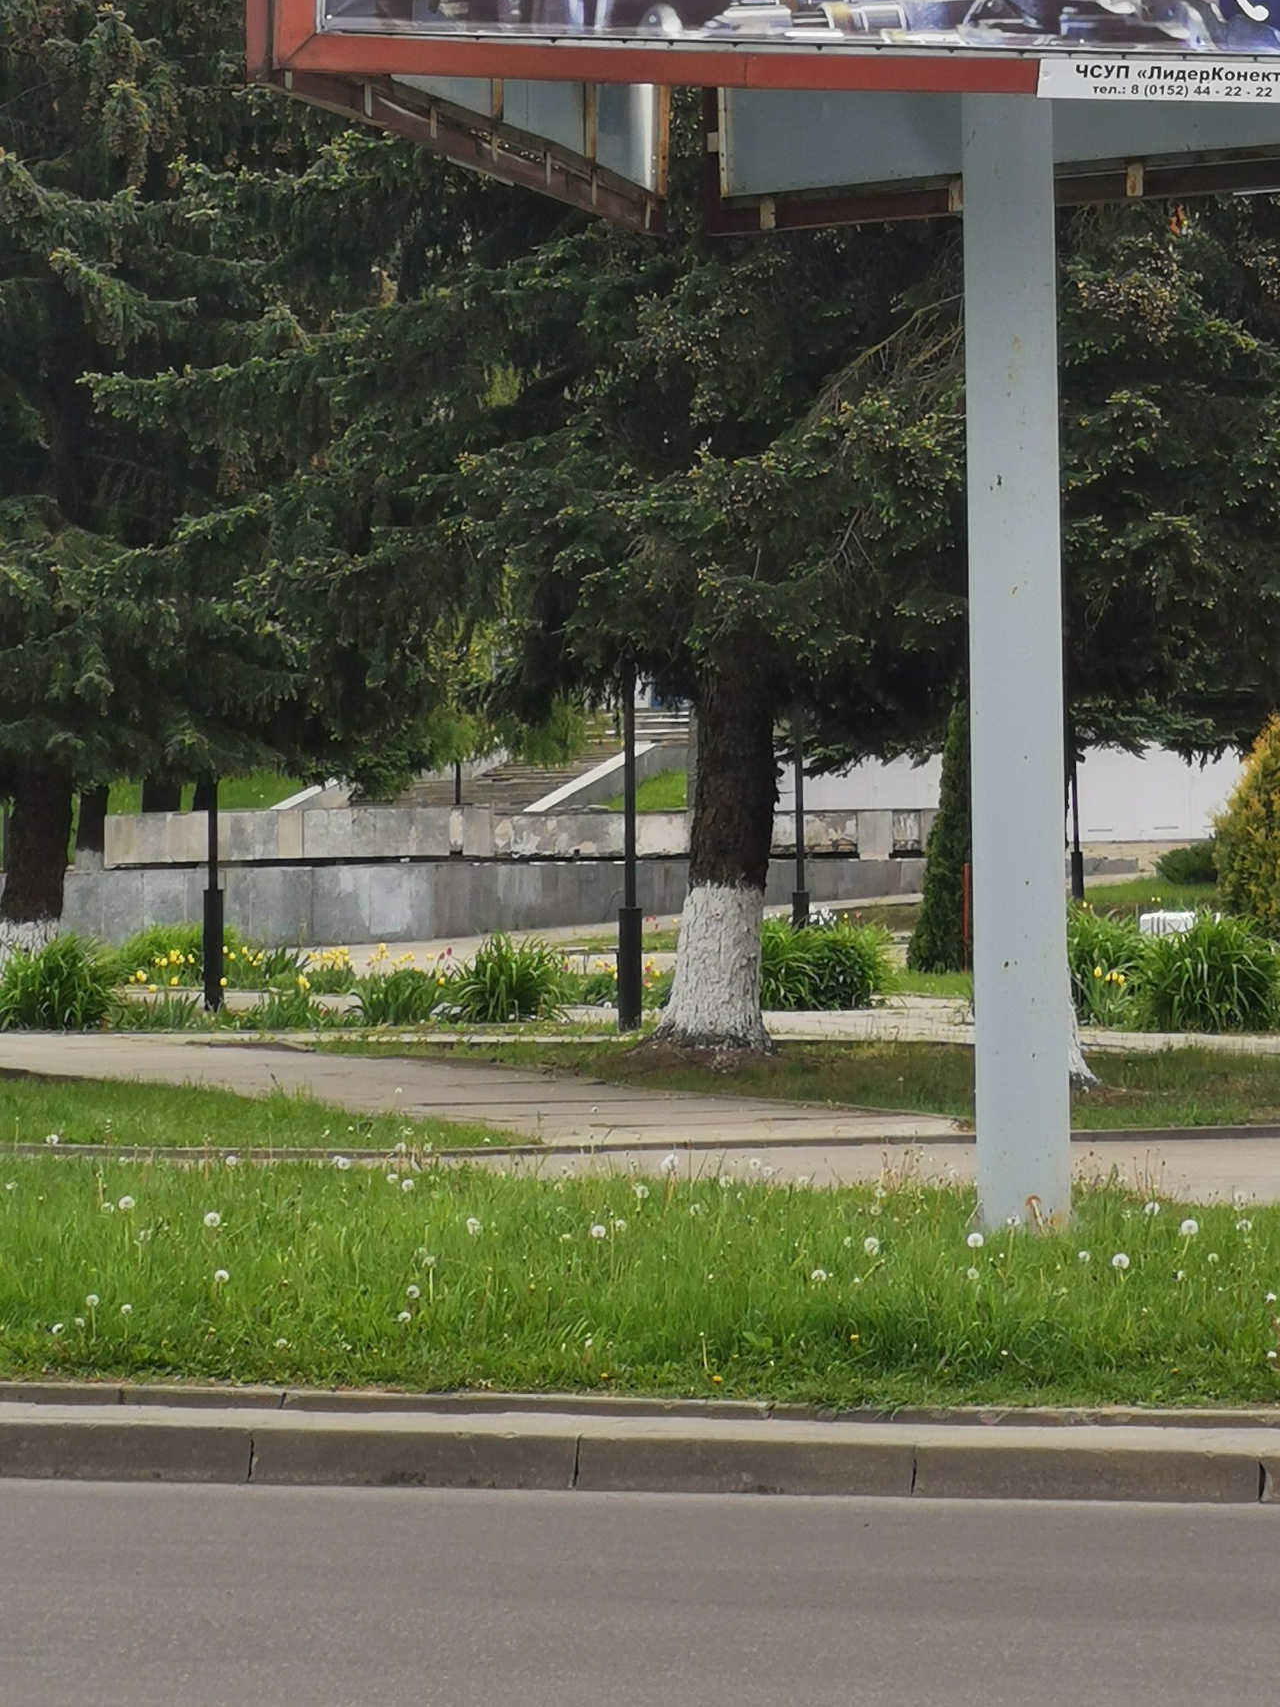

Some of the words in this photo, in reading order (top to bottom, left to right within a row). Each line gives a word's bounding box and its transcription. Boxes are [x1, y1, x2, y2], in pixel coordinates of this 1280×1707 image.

[1075, 64, 1130, 80] ЧСУП
[1092, 84, 1127, 95] тел.:
[1130, 84, 1139, 95] 8
[1143, 84, 1189, 98] (0152)
[1193, 85, 1211, 96] 44
[1224, 85, 1242, 97] 22
[1255, 86, 1273, 97] 22
